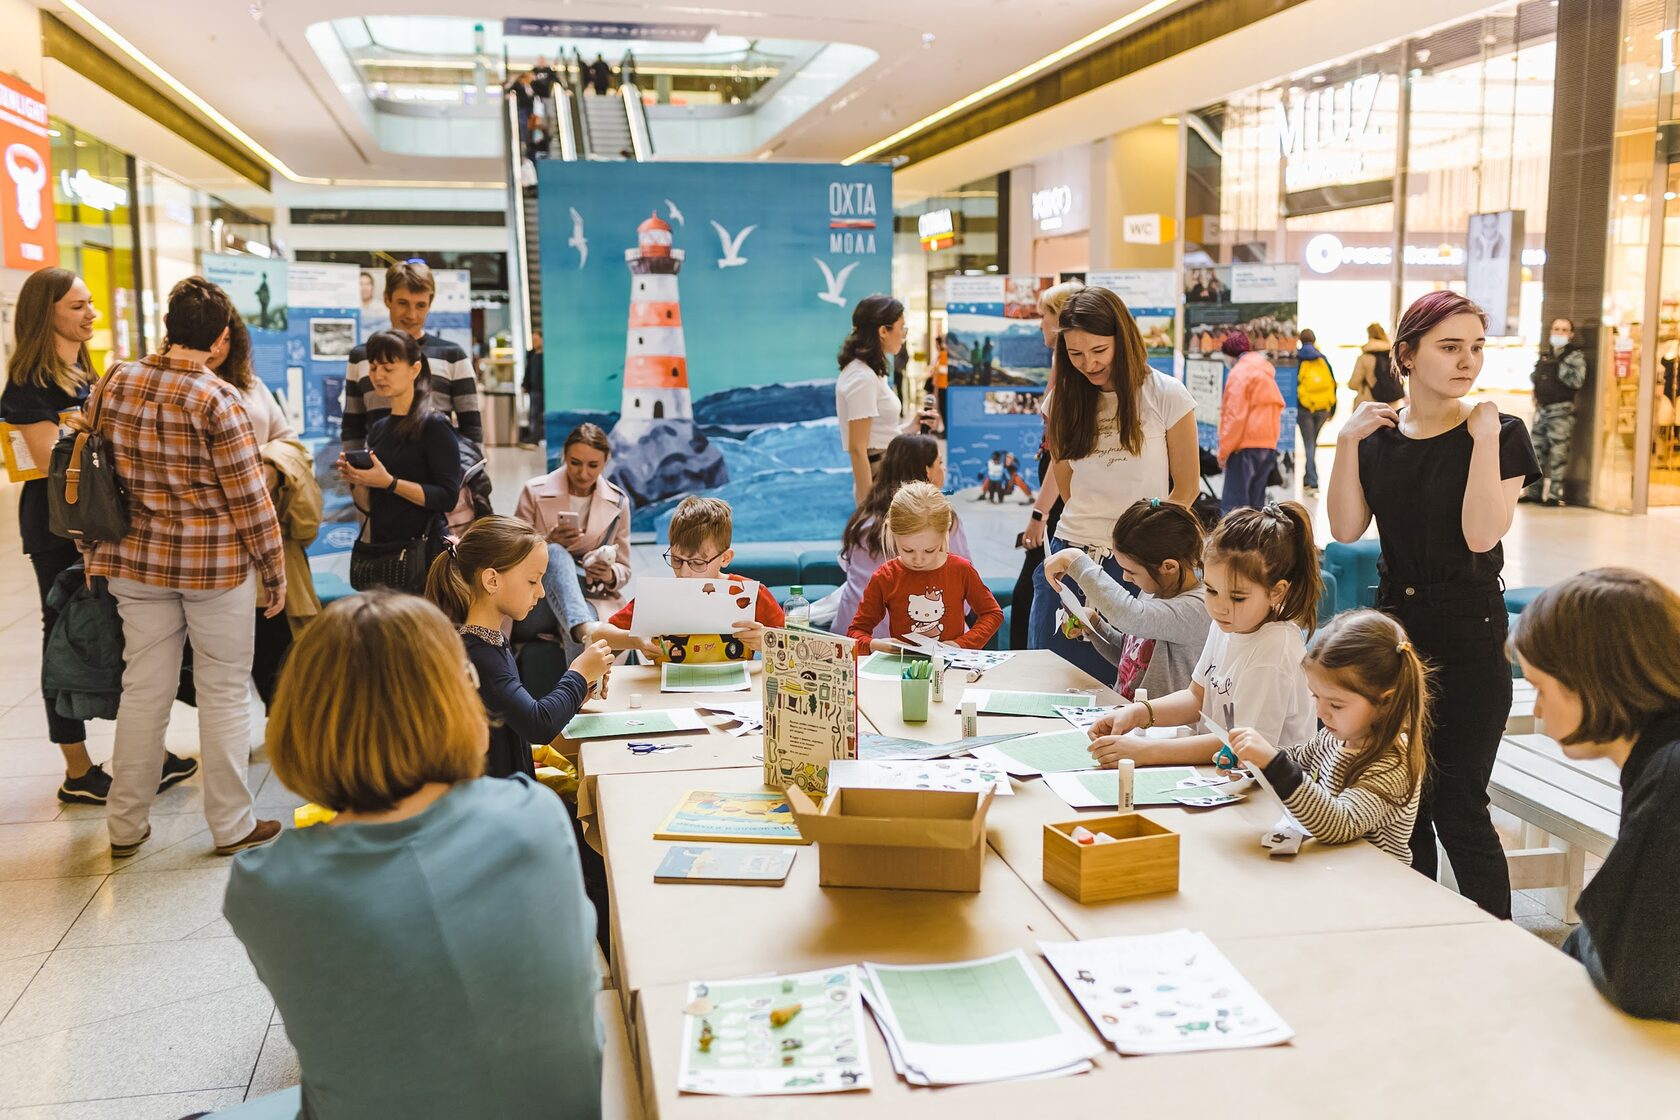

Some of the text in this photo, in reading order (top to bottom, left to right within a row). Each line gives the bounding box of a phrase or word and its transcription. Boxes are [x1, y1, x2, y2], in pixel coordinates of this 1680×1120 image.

[829, 182, 877, 216] ОХТА
[1129, 222, 1154, 236] WC
[829, 232, 877, 255] МОЛЛ
